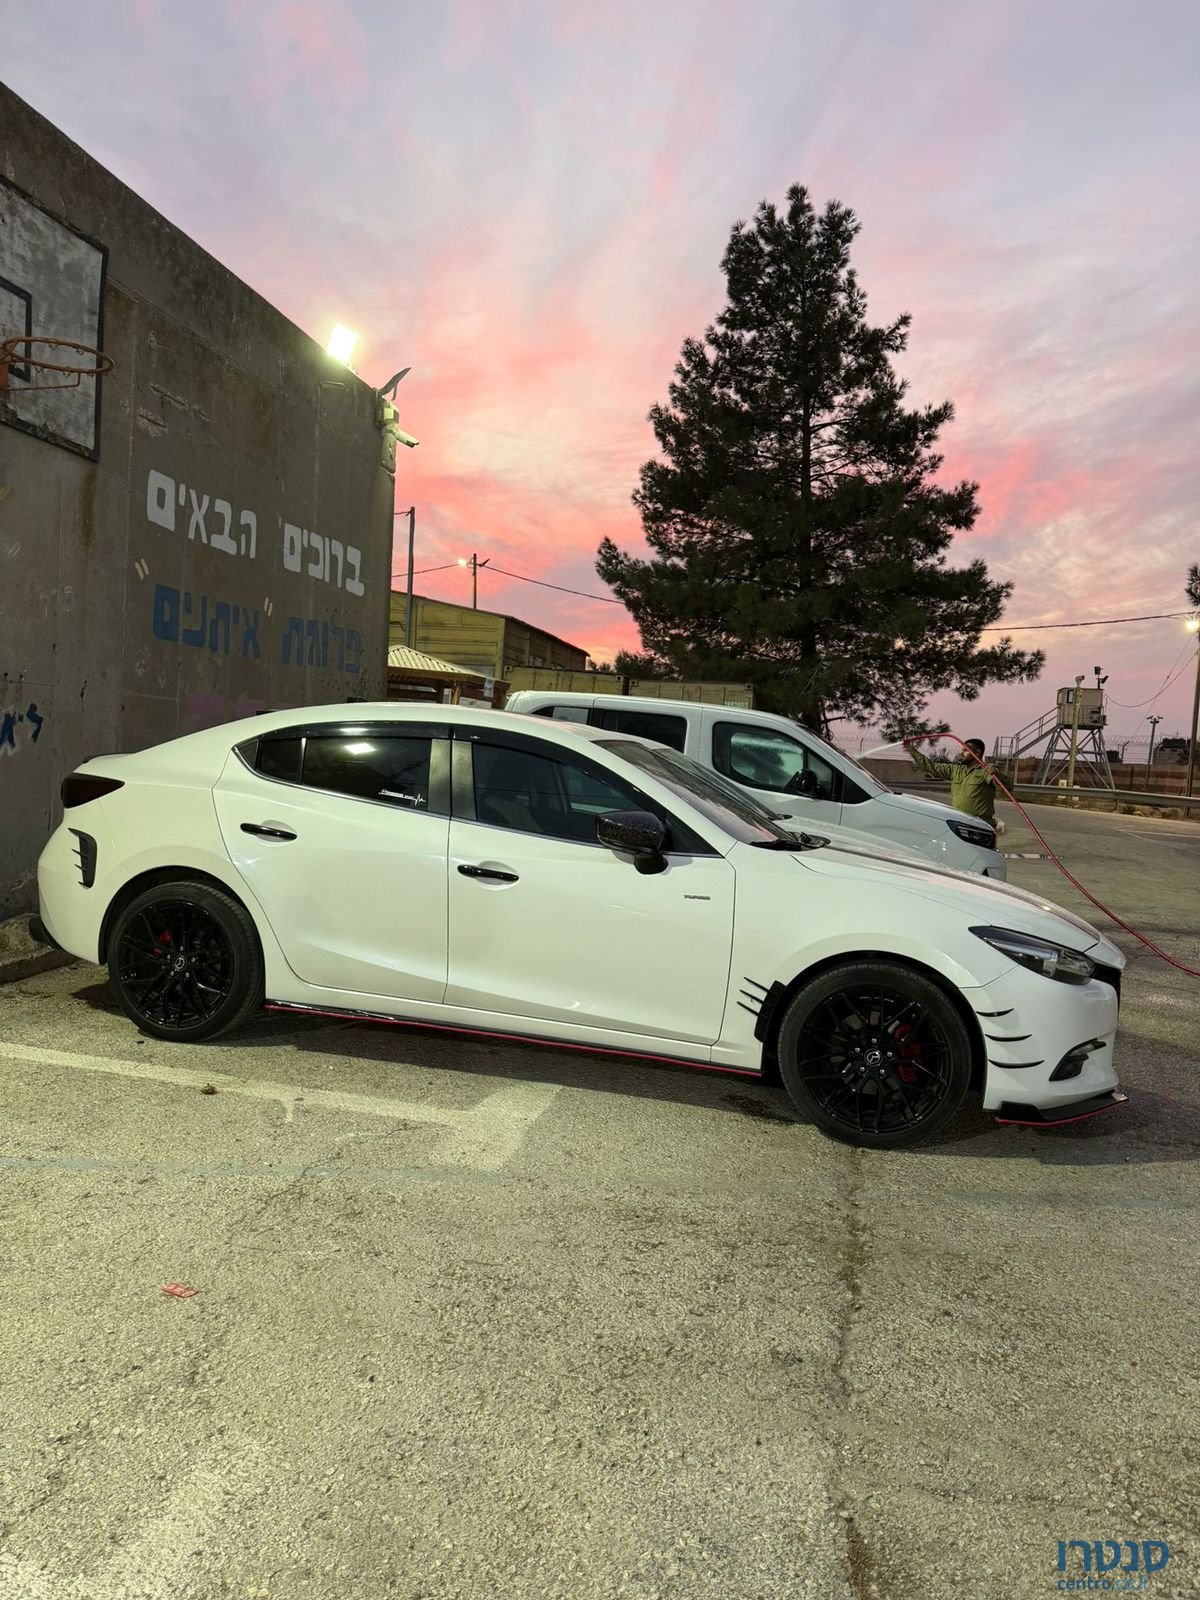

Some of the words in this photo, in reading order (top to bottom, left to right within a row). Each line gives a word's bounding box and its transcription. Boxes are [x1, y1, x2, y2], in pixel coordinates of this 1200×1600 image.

[147, 469, 257, 559] הבאים
[283, 522, 365, 597] ברוכים
[281, 616, 362, 674] פלוגת
